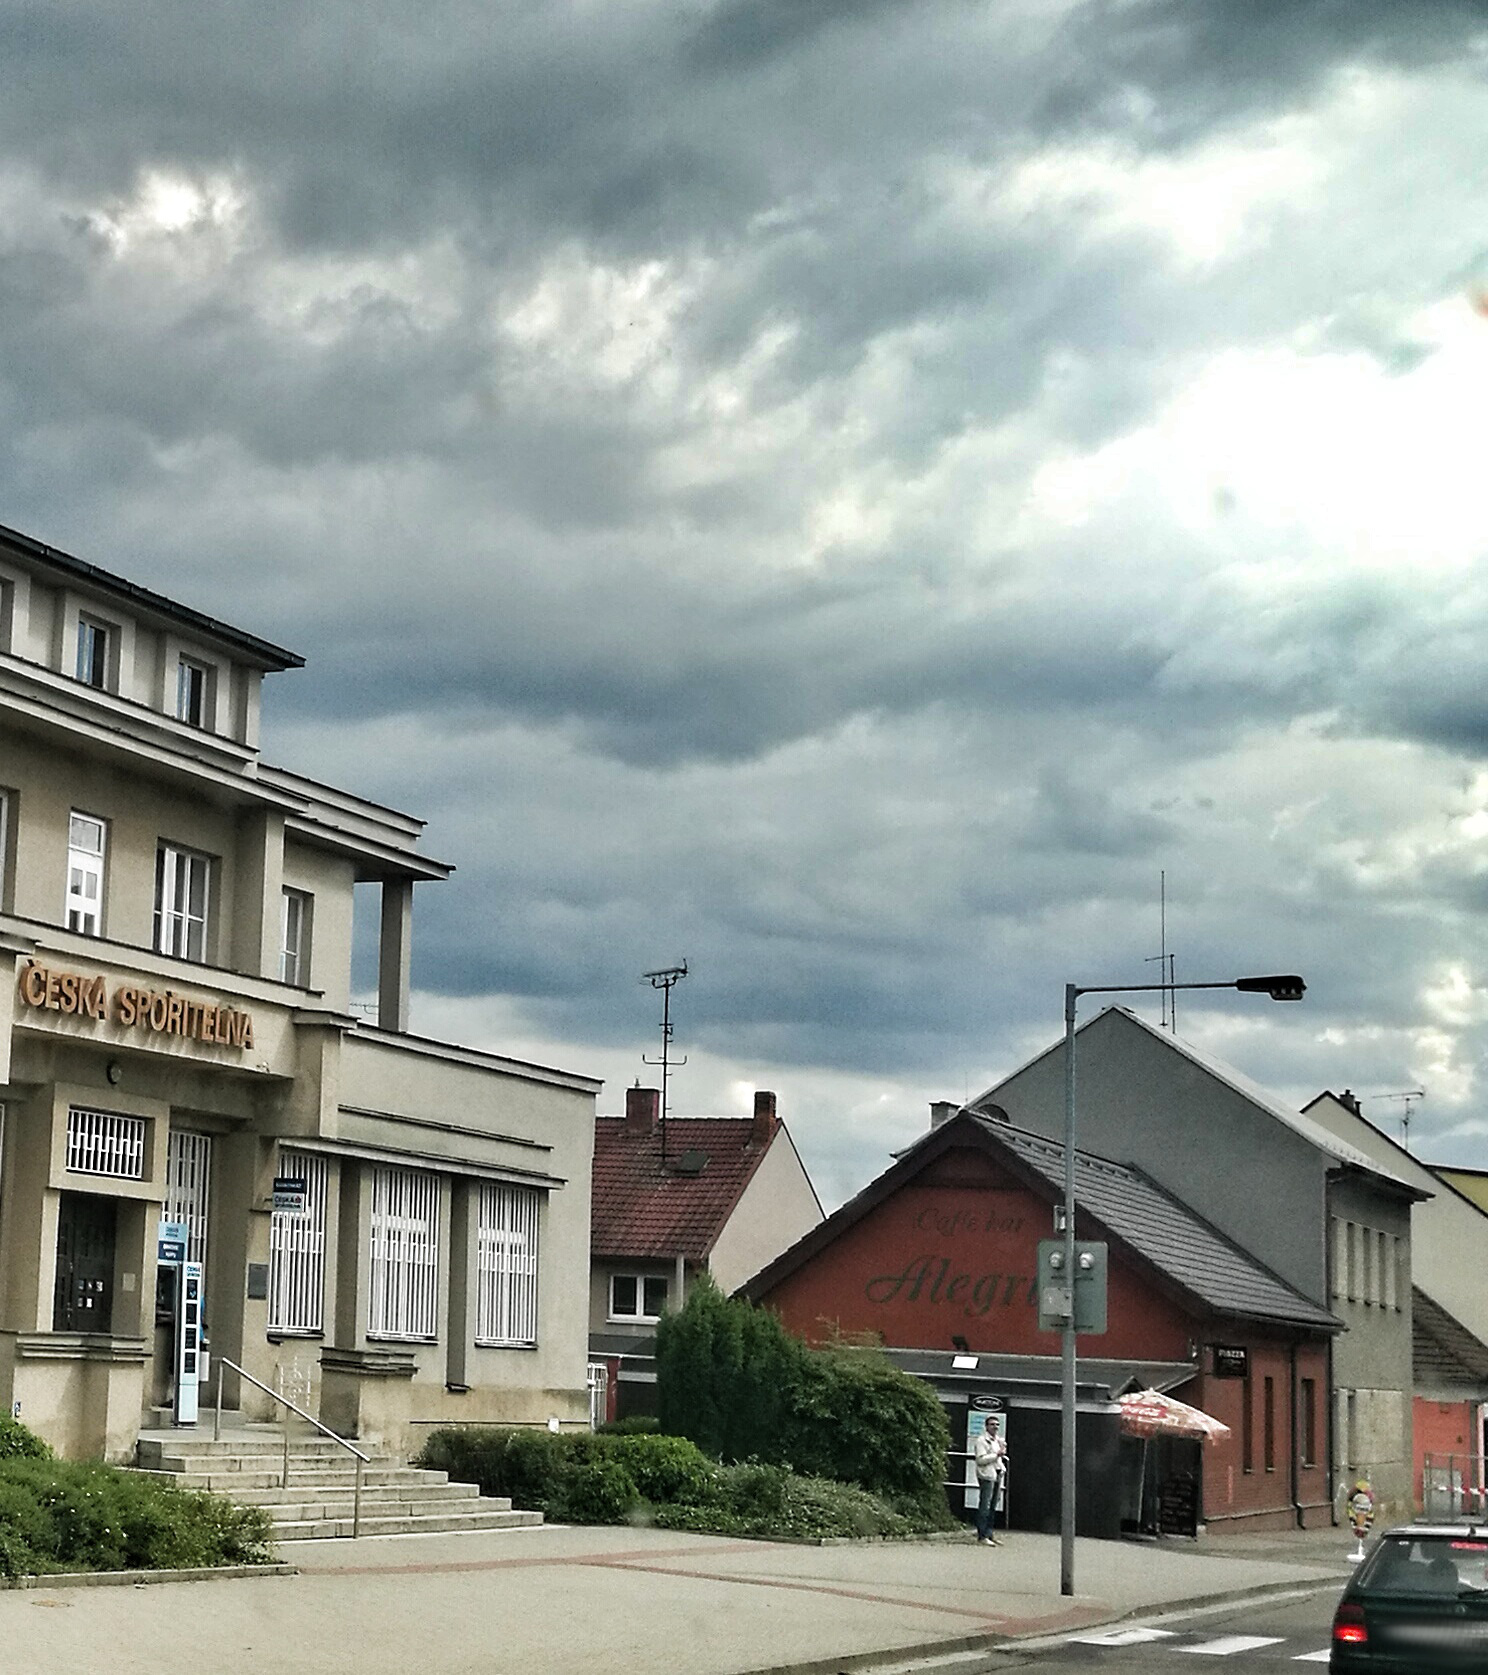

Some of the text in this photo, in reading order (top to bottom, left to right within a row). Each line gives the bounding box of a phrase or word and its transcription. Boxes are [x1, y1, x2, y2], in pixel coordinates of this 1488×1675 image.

[20, 959, 256, 1050] ČESKÁ SPOŘITELNA
[865, 1254, 1040, 1316] Alegri
